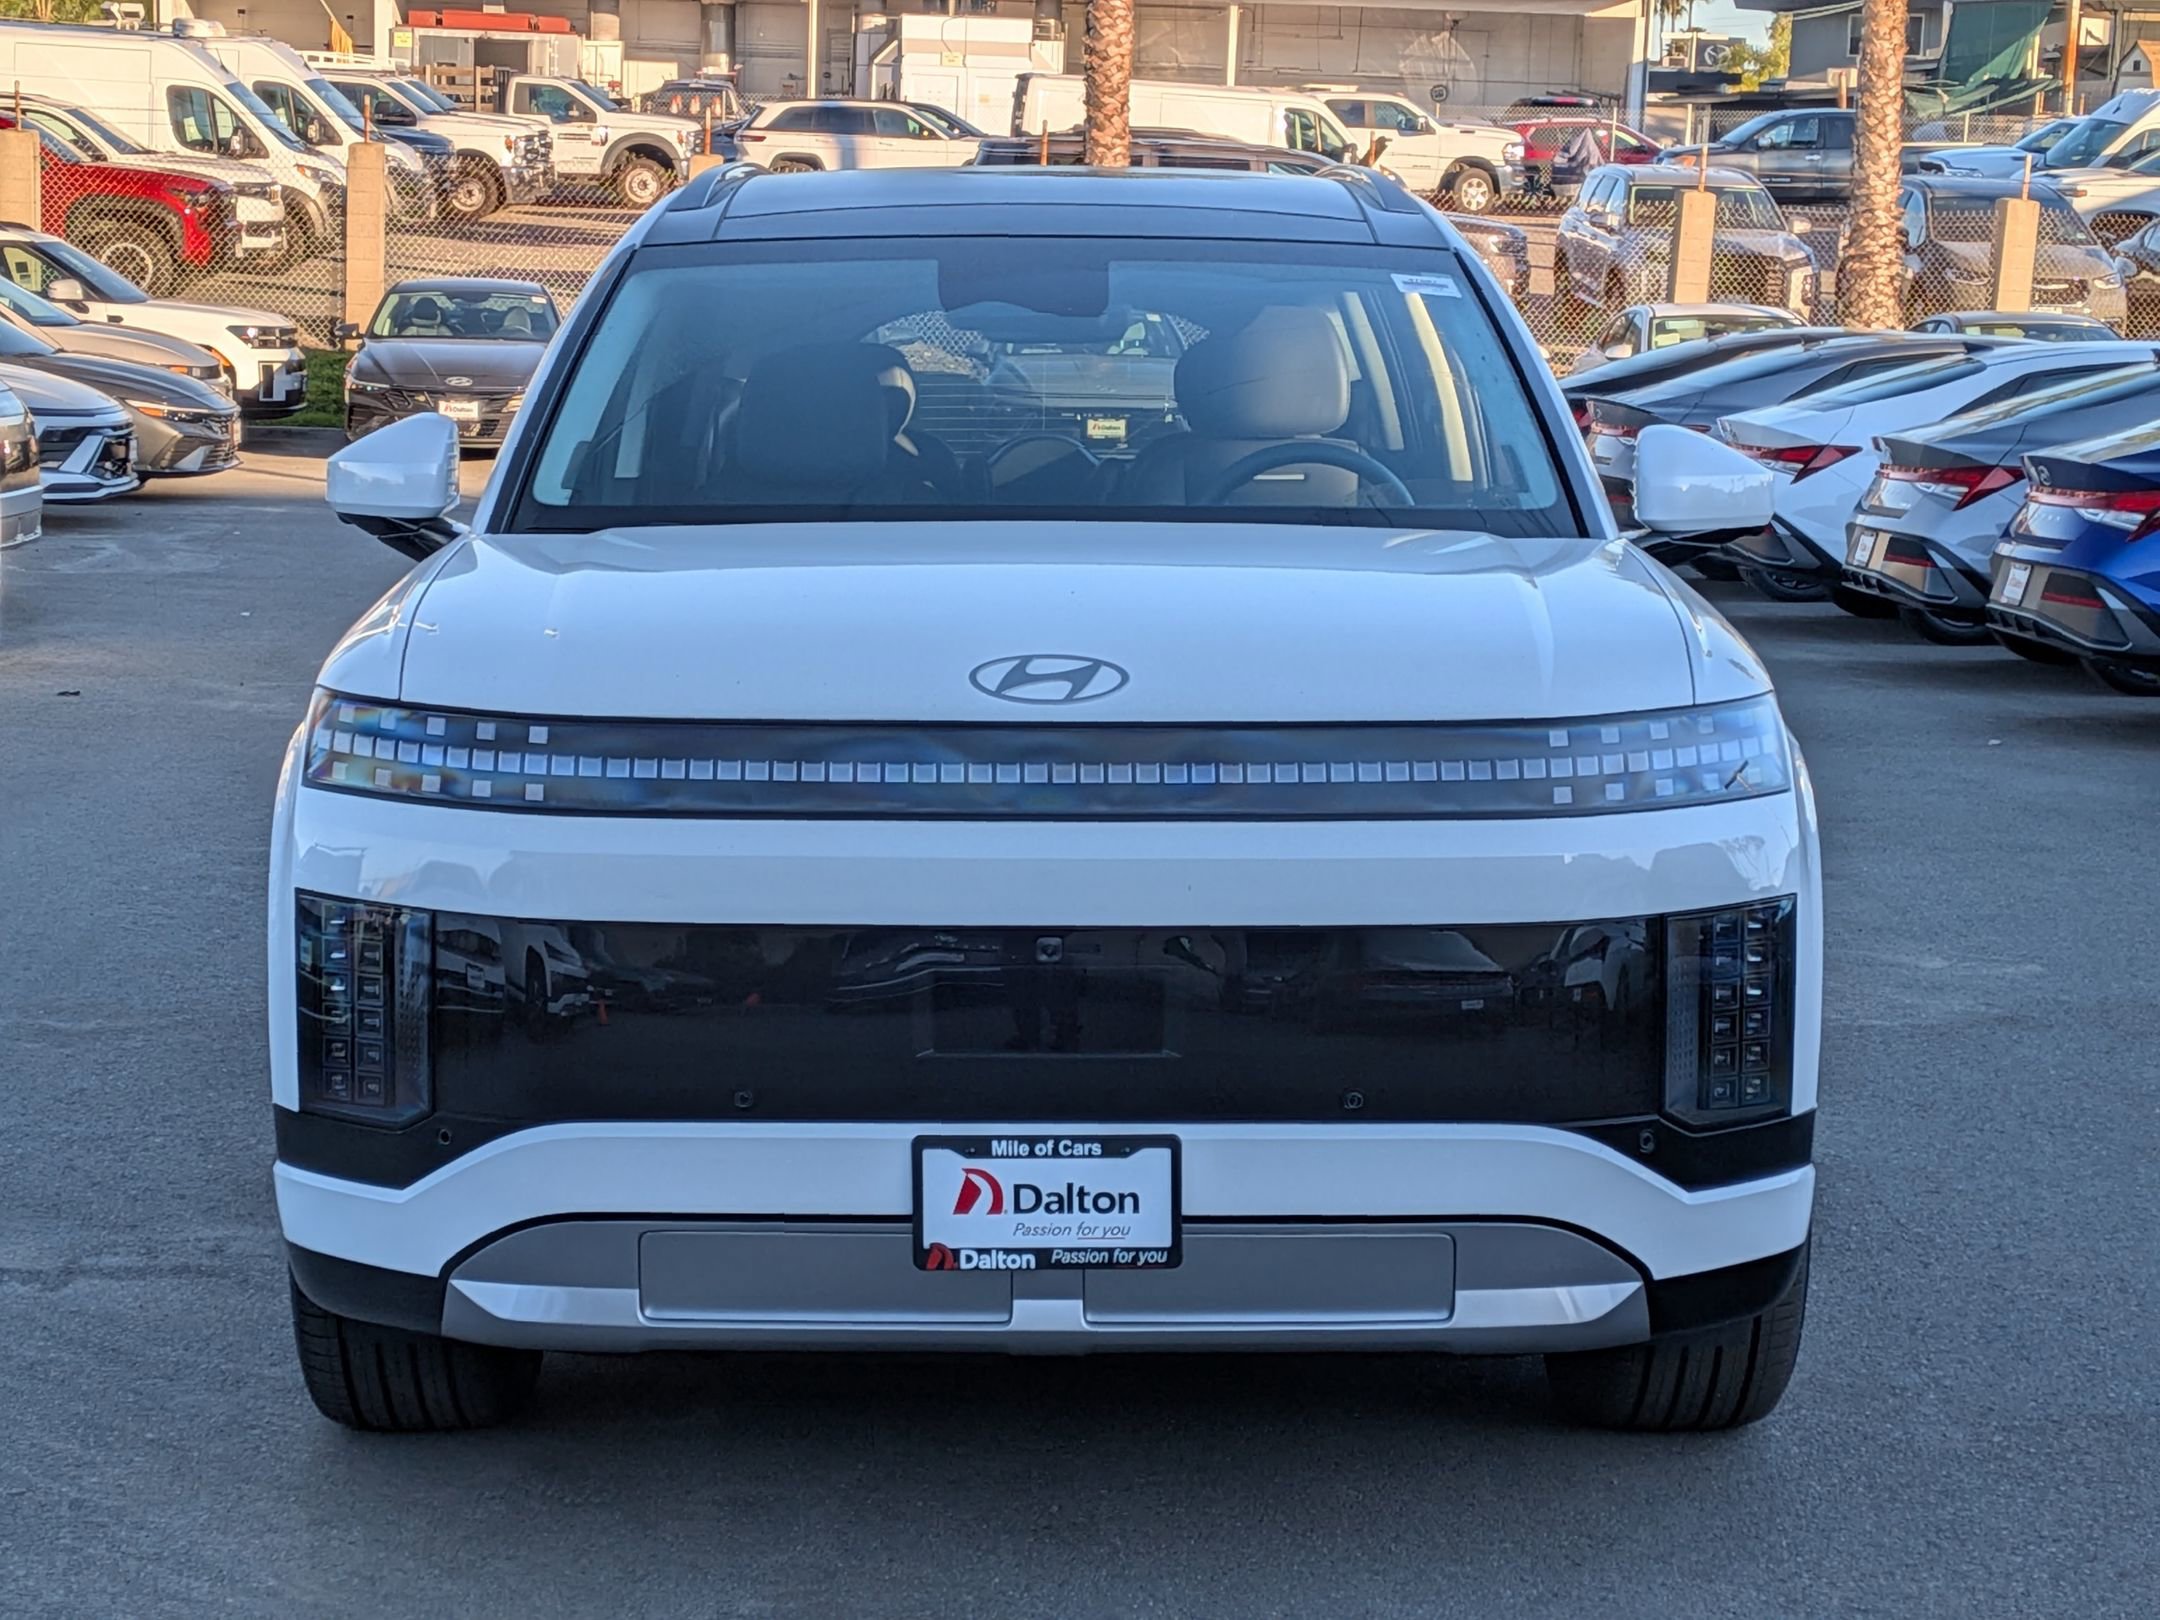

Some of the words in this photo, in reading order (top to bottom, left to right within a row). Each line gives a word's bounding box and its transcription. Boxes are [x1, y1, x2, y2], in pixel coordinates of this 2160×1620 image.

[991, 1139, 1029, 1156] Mile
[1035, 1139, 1054, 1156] of
[1058, 1139, 1102, 1156] Cars
[1013, 1182, 1140, 1215] Dalton
[1012, 1222, 1072, 1237] Passion
[1076, 1222, 1100, 1238] for
[1102, 1227, 1131, 1239] you
[959, 1249, 1036, 1270] Dalton
[1051, 1248, 1109, 1264] Passion
[1112, 1248, 1136, 1264] for
[1138, 1250, 1168, 1267] you
